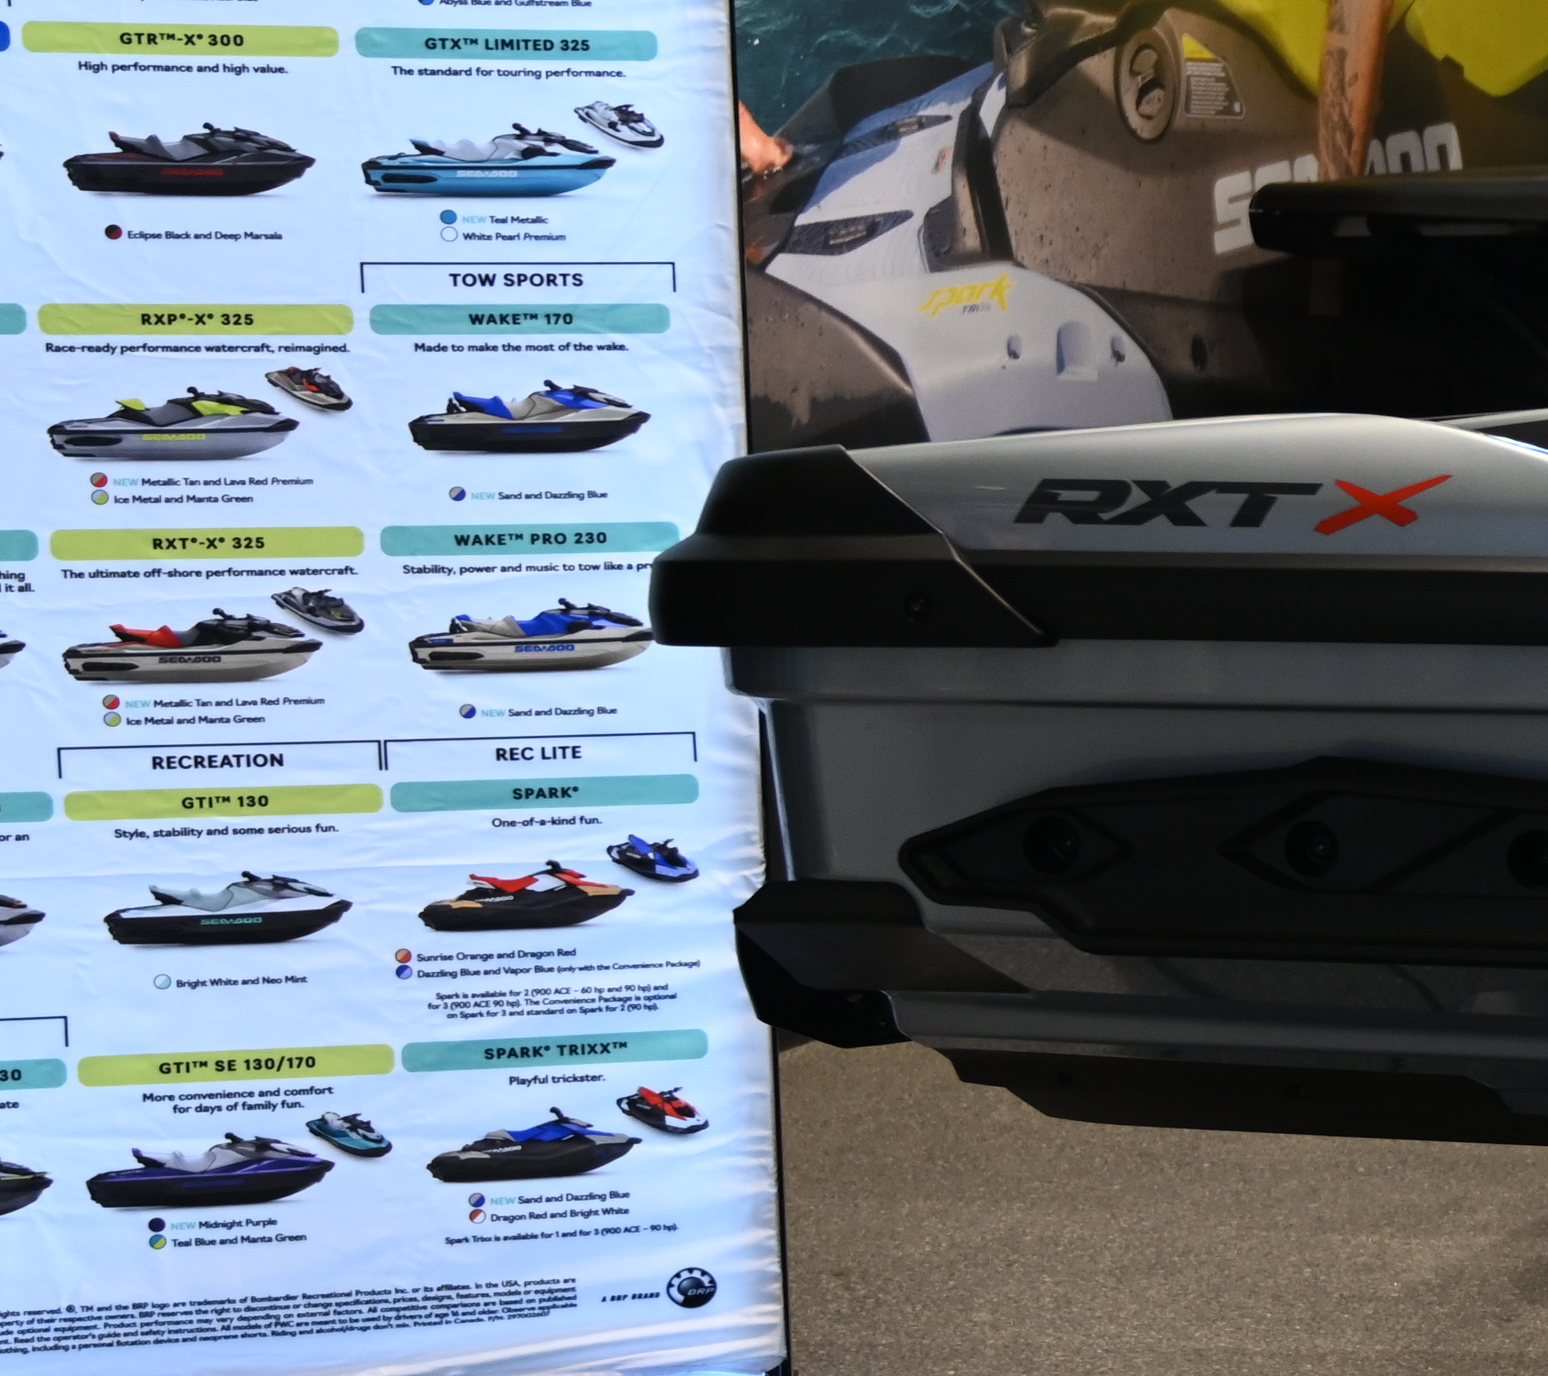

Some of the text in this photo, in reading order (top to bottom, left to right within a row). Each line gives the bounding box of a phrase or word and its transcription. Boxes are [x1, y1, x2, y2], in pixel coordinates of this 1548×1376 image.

[207, 33, 243, 46] 300
[484, 38, 554, 51] LIMITED
[559, 39, 590, 51] 325
[77, 60, 288, 76] High performance and high value.
[390, 65, 626, 80] The standard for touring performance.
[462, 214, 548, 224] NEW Teal Metallic
[462, 232, 566, 241] White Pearl Premium
[448, 272, 583, 286] TOW SPORTS
[220, 312, 253, 325] 325
[542, 312, 573, 325] 170
[44, 342, 350, 355] Race-ready performance watercraft, reimagined.
[413, 341, 629, 352] Made to make the most of the wake.
[113, 493, 253, 504] Ice Metal and Manta Green
[1013, 474, 1454, 536] RXT X
[231, 536, 264, 549] 325
[530, 532, 567, 545] PRO
[573, 531, 606, 544] 230
[60, 565, 358, 579] The ultimate off-shore performance watercraft.
[402, 564, 456, 575] Stability,
[458, 565, 498, 575] power
[500, 562, 522, 572] and
[525, 562, 559, 571] music
[562, 563, 575, 571] to
[577, 563, 601, 571] tow
[603, 561, 624, 570] like
[495, 745, 582, 761] REC LITE
[151, 753, 284, 769] RECREATION
[236, 794, 268, 807] 130
[491, 815, 602, 827] One-of-a-kind fun.
[113, 822, 338, 840] Style, stability and some serious fun.
[416, 948, 576, 962] Sunrise Orange and Dragon Red
[214, 1059, 236, 1072] SE
[243, 1055, 315, 1071] 130/170
[508, 1073, 606, 1087] Playful trickster.
[142, 1085, 334, 1102] More convenience and comfort
[172, 1099, 304, 1114] for days of family fun.
